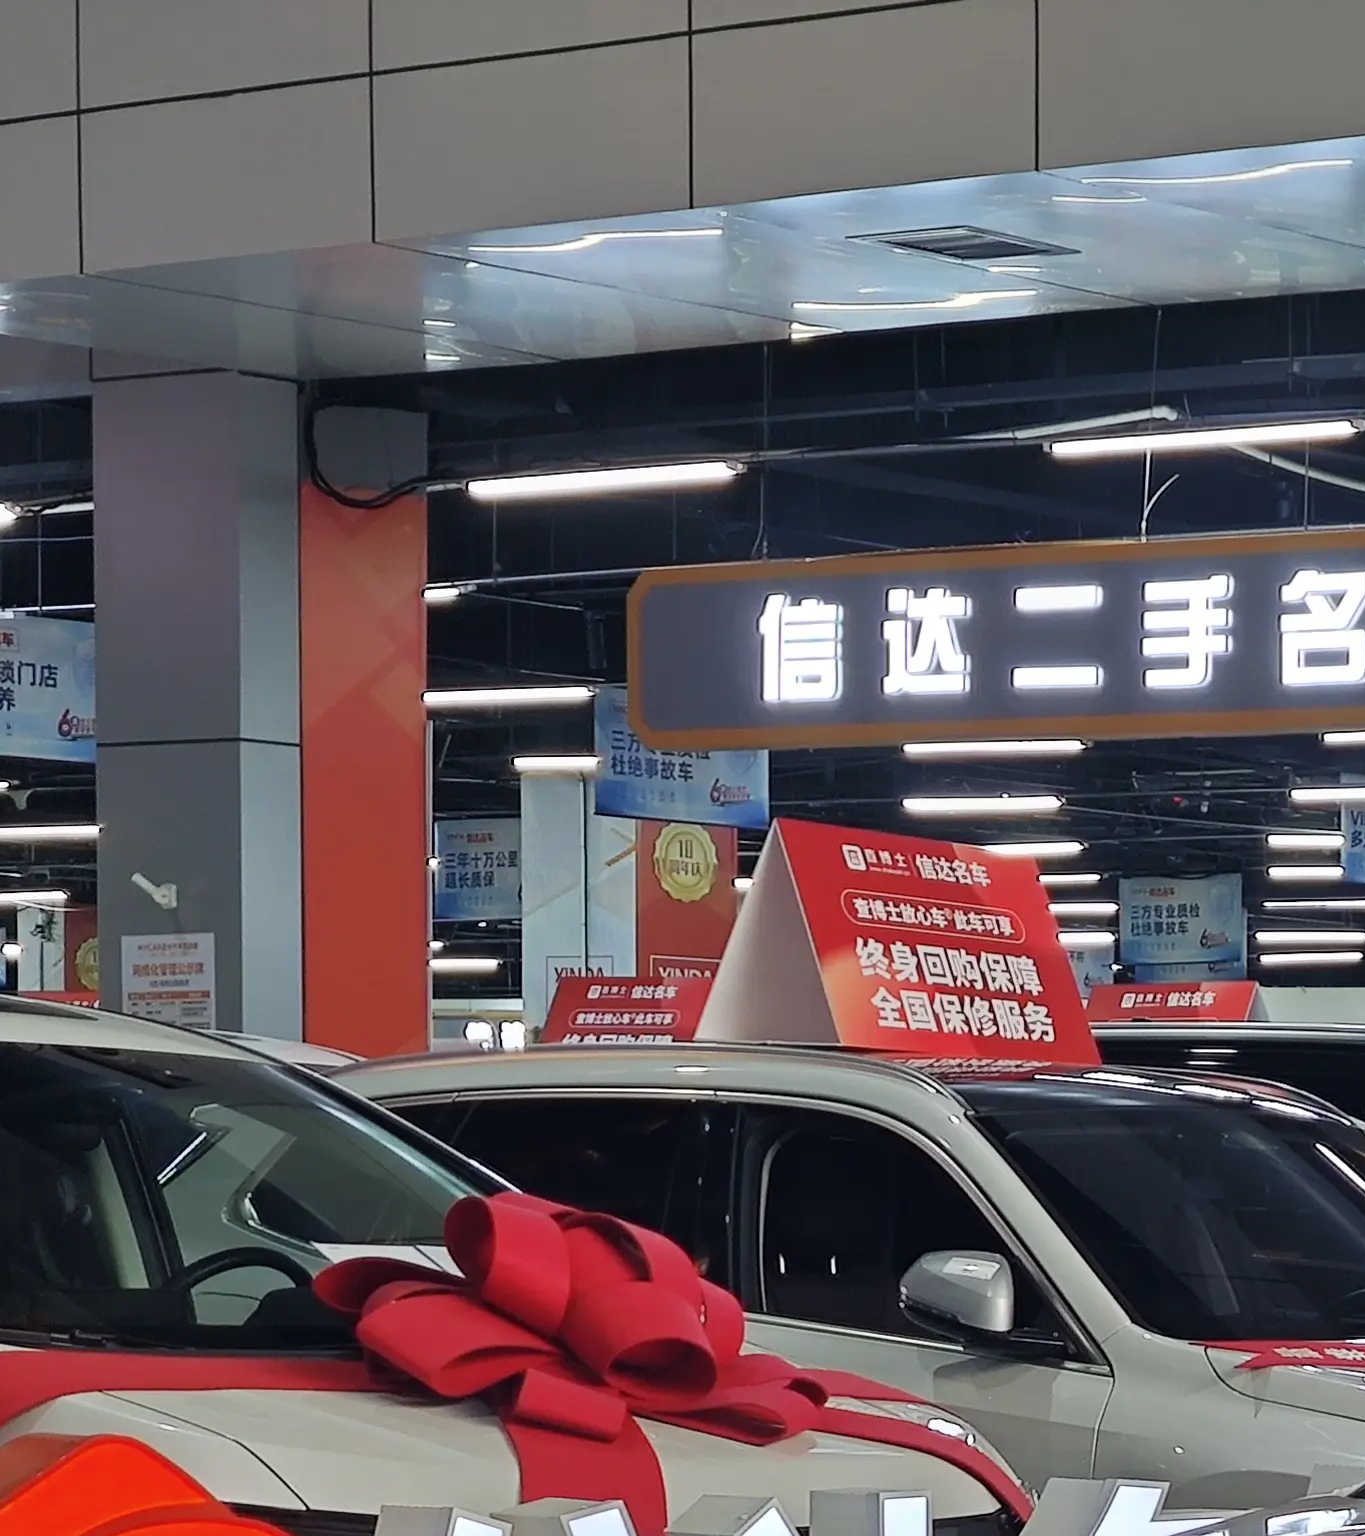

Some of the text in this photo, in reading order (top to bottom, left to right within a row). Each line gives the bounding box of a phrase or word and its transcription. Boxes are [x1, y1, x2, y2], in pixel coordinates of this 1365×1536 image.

[0, 632, 14, 648] 车
[610, 754, 694, 782] 杜绝事故车
[445, 850, 518, 868] 三年十万公里
[915, 853, 992, 887] 信达名车
[445, 871, 495, 888] 超长质保
[1130, 903, 1200, 919] 三方专业质检
[854, 936, 1044, 997] 终身回购保障
[631, 985, 678, 999] 信达名车
[1167, 990, 1217, 1008] 信达名车
[870, 986, 1056, 1043] 全国保修服务
